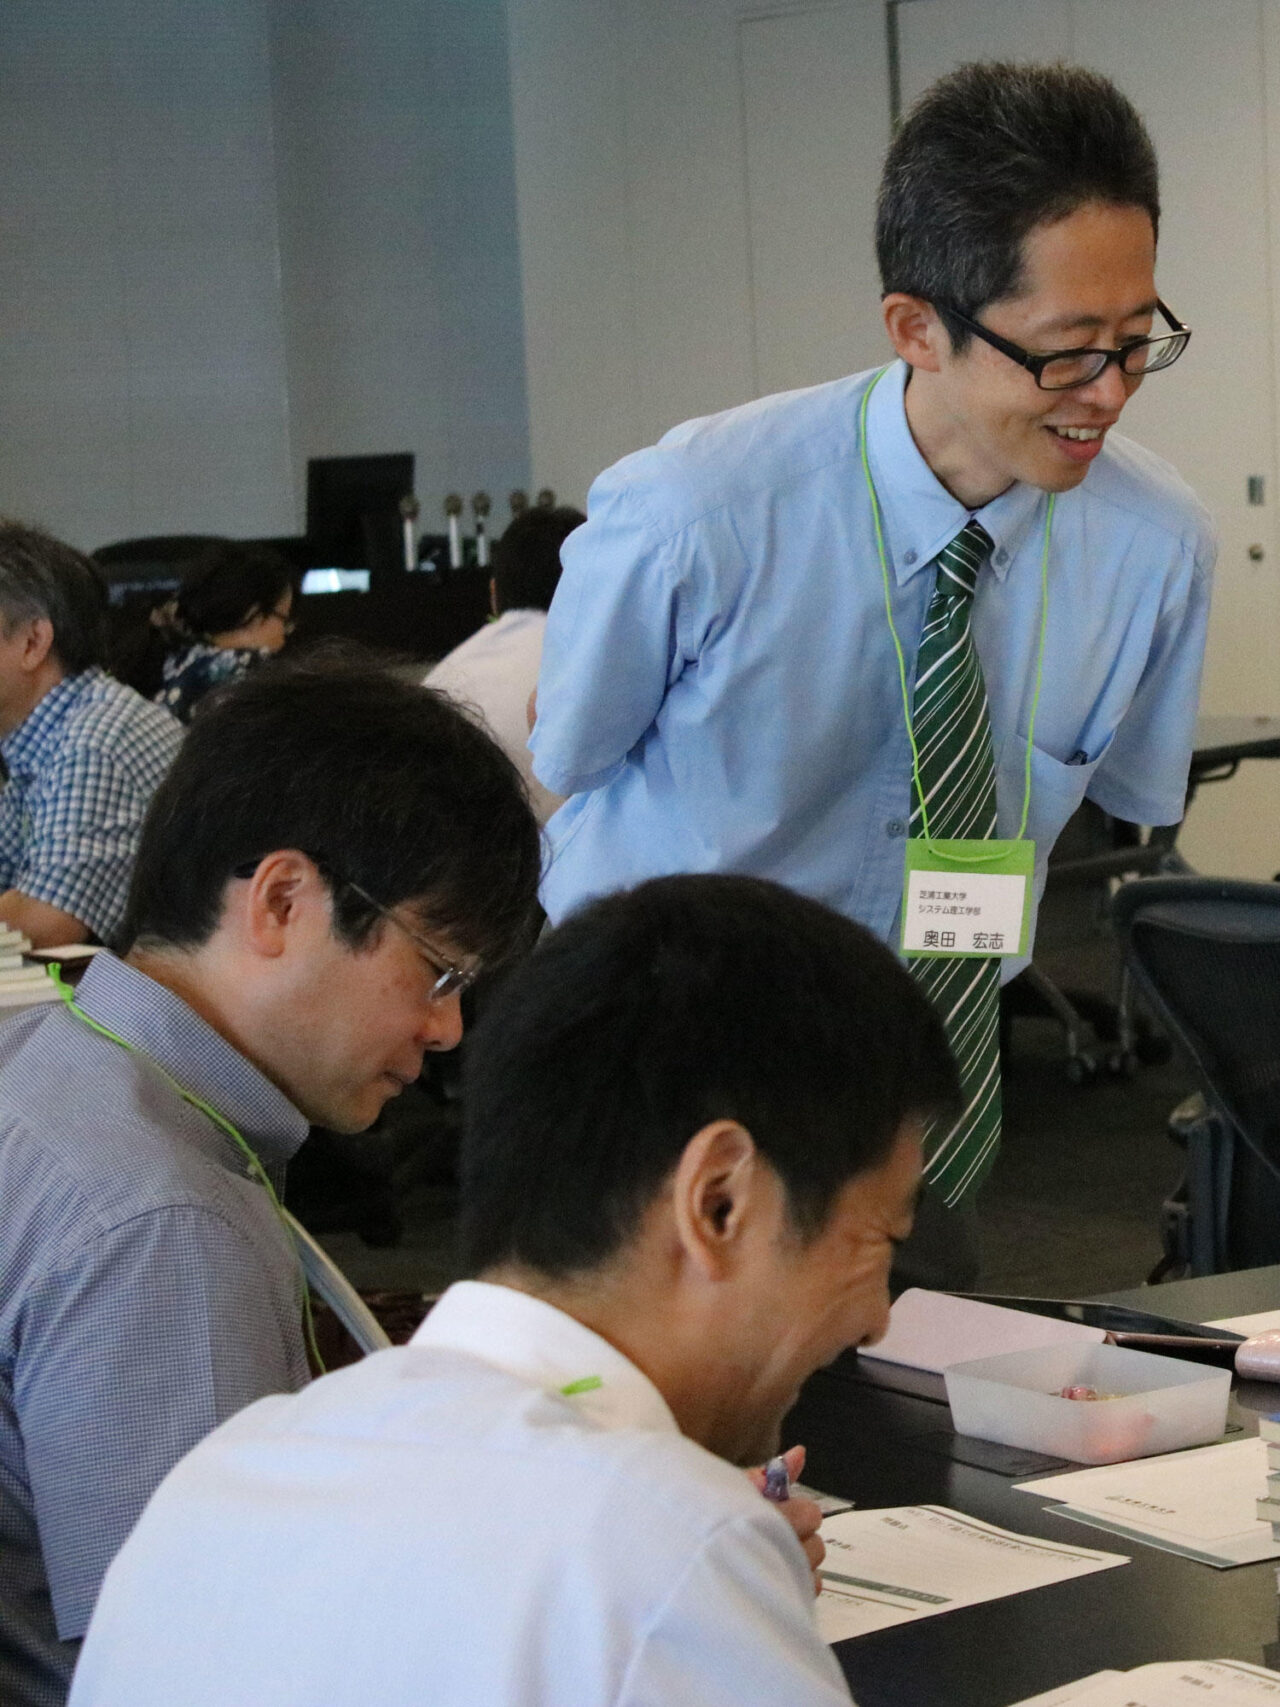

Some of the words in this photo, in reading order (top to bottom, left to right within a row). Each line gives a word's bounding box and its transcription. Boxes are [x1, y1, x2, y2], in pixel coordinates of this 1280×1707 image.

[919, 890, 967, 901] 芝浦工業大学
[918, 905, 981, 916] システム理工学部
[923, 930, 956, 948] 奥田
[972, 931, 1005, 949] 宏志
